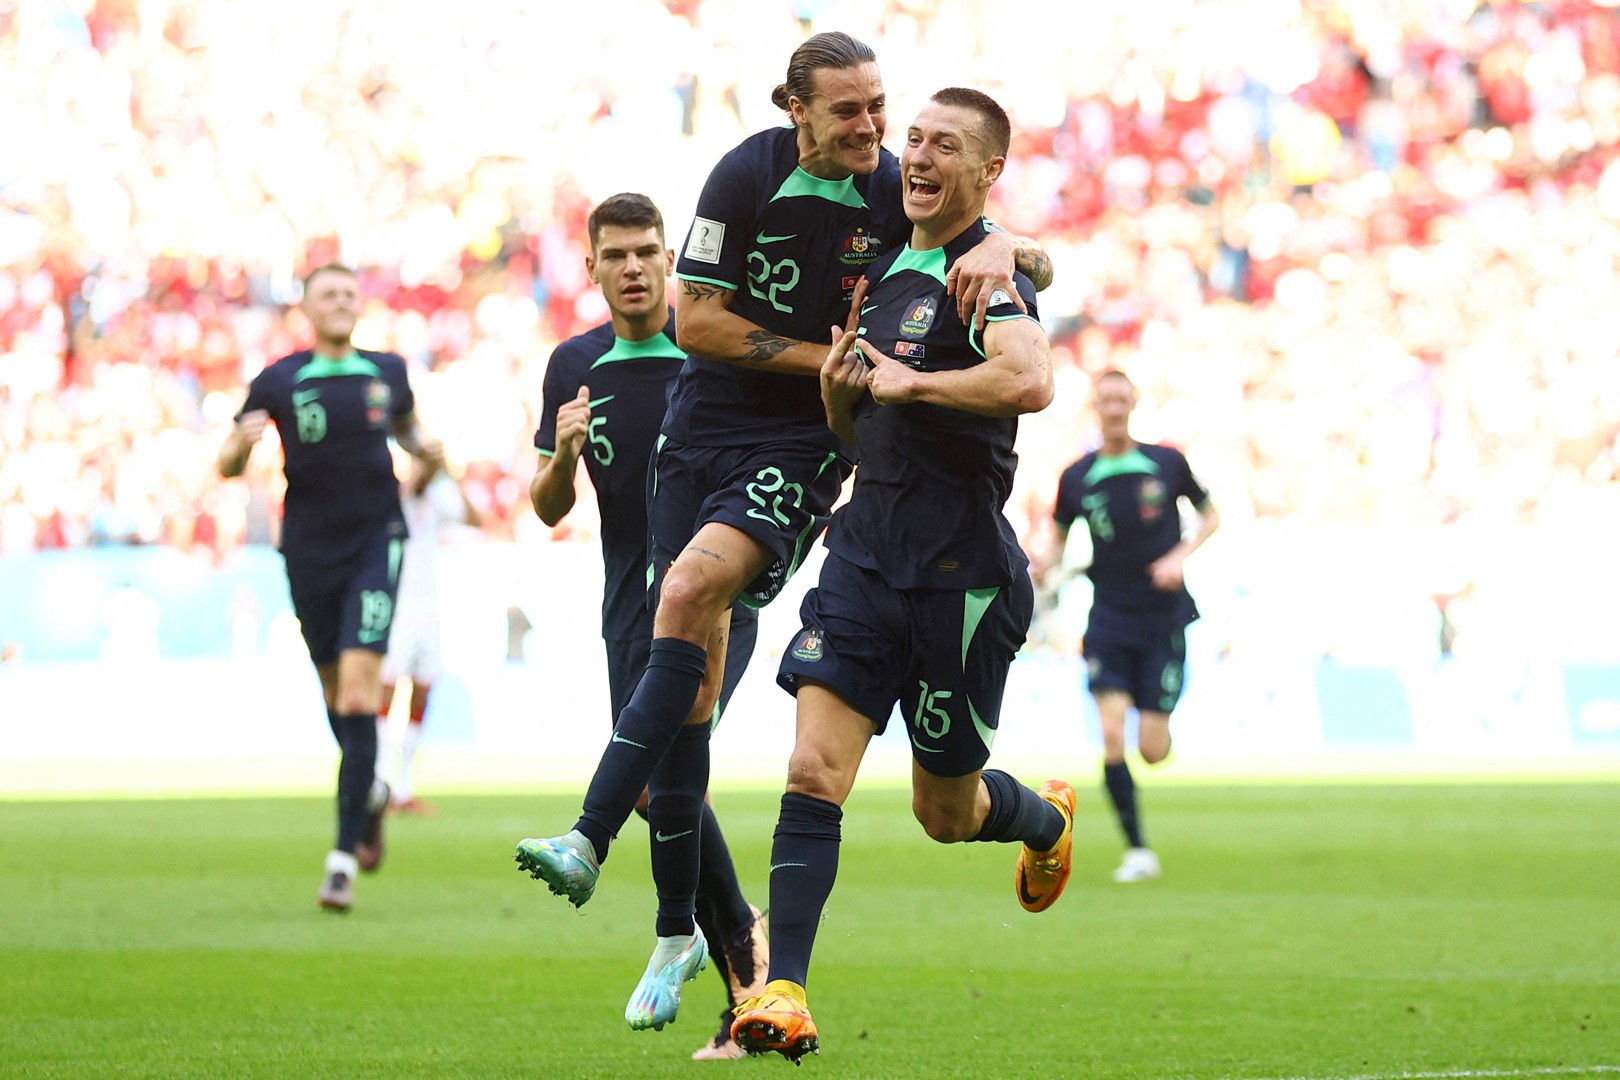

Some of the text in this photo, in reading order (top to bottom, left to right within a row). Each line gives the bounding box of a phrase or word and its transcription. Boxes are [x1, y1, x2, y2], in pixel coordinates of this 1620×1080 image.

[746, 250, 801, 314] 22
[295, 401, 328, 443] 19
[588, 416, 615, 466] 5
[745, 466, 804, 526] 22
[361, 590, 391, 631] 19
[914, 679, 953, 739] 15
